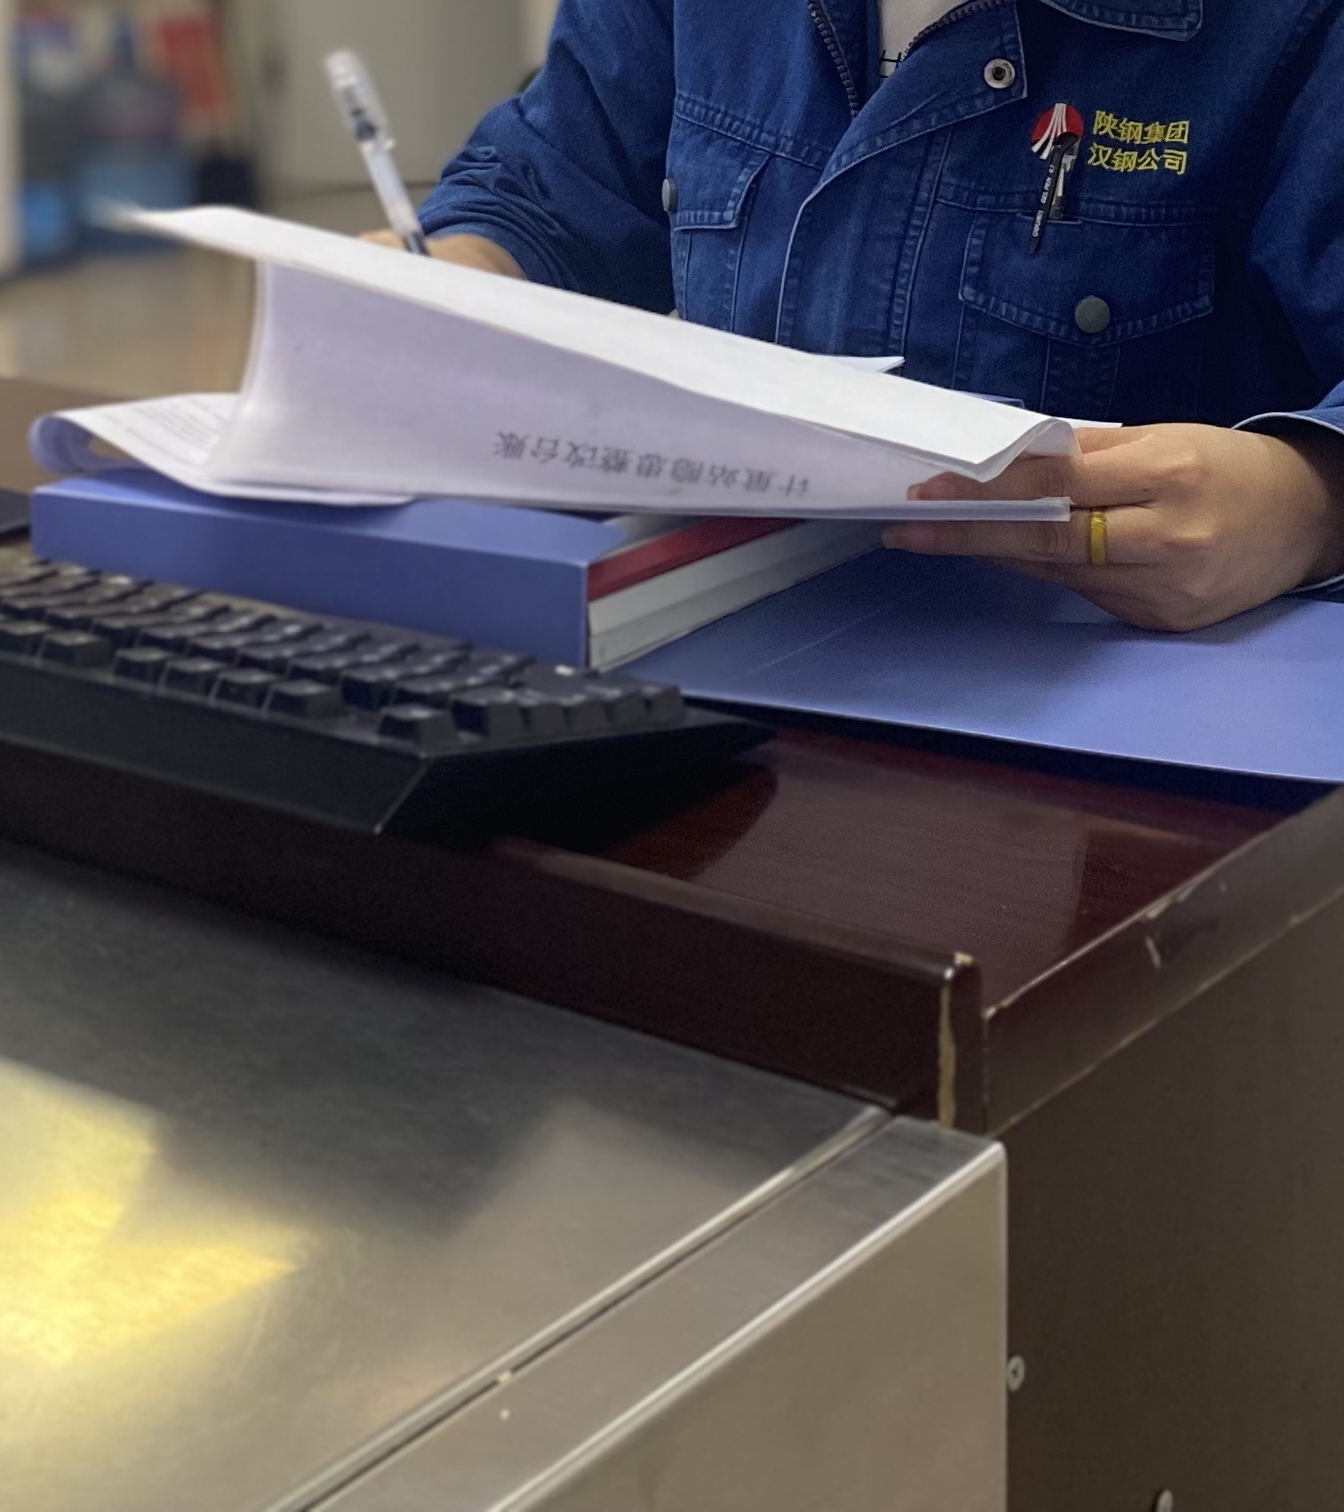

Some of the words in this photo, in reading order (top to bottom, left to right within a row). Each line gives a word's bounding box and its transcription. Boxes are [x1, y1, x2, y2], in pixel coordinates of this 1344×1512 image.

[1093, 109, 1190, 144] 陕钢集团
[1087, 141, 1187, 175] 汉钢公司
[494, 431, 810, 498] 计量站隐患整改台账
